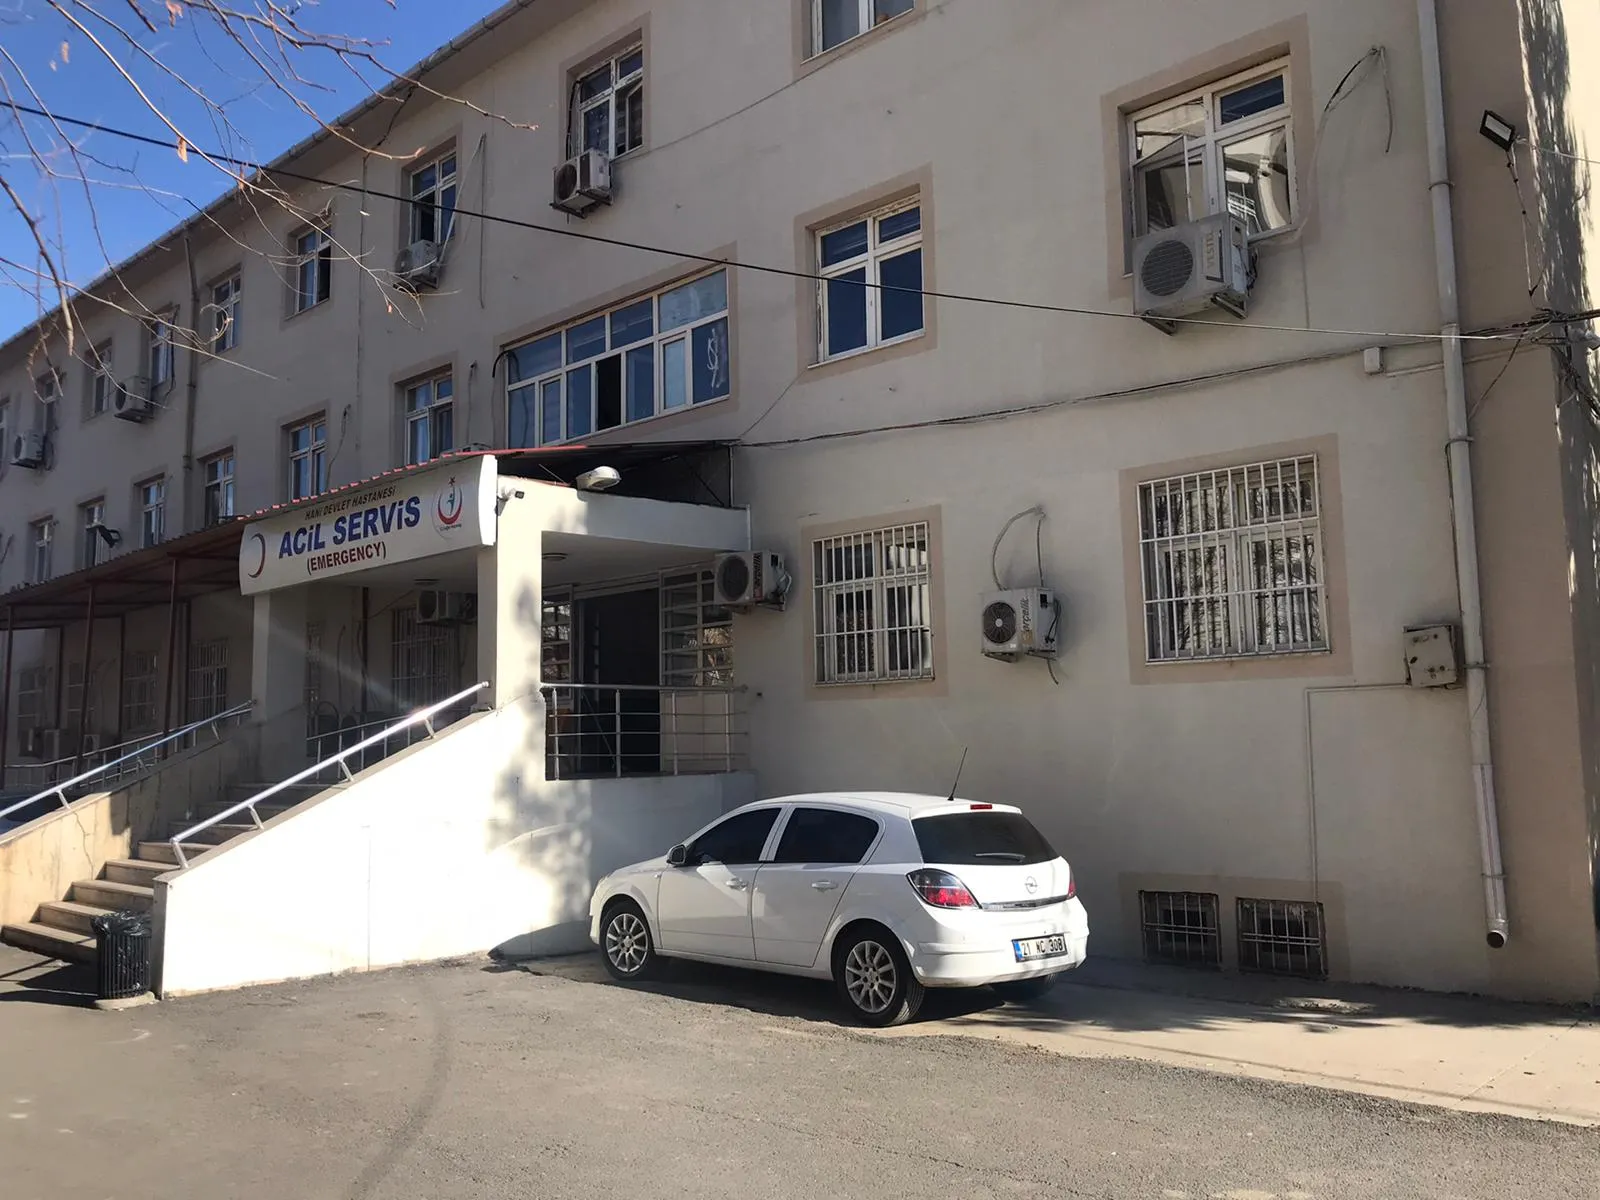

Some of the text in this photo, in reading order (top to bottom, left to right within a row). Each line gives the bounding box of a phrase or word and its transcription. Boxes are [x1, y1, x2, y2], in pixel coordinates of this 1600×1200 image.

[323, 499, 352, 516] DEVLET
[307, 541, 387, 576] (EMERGENCY)
[1021, 942, 1032, 956] 21
[1048, 937, 1063, 952] 308
